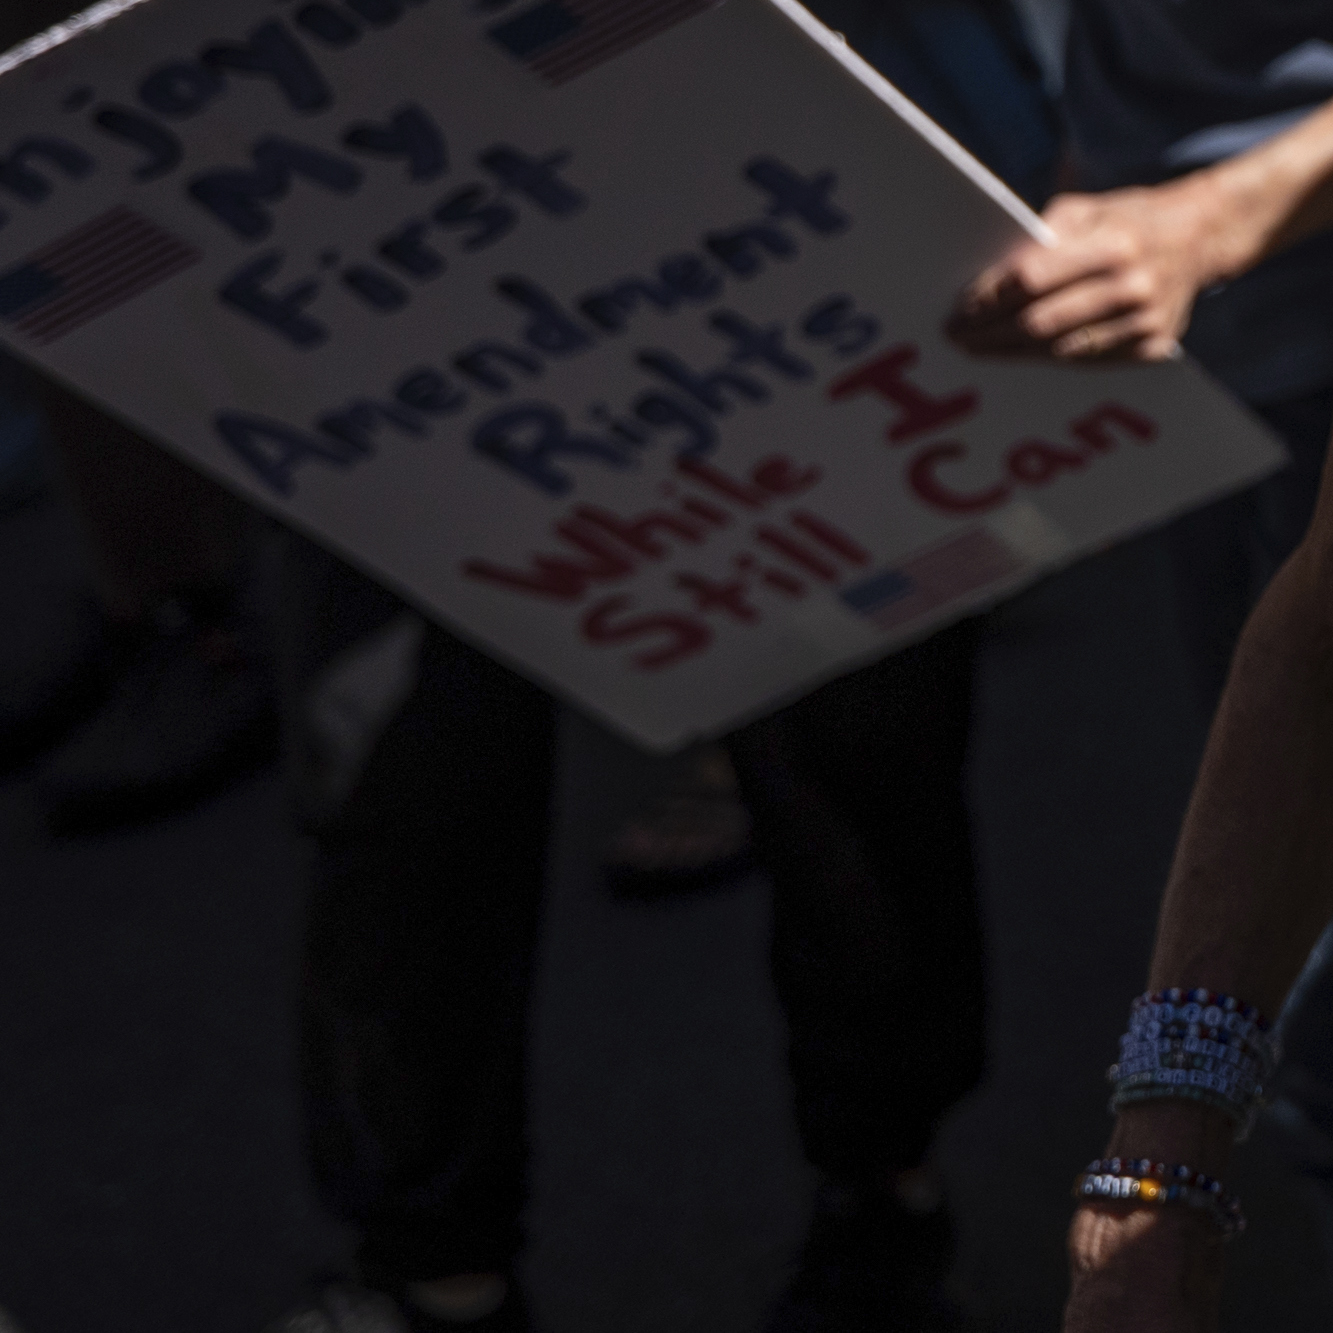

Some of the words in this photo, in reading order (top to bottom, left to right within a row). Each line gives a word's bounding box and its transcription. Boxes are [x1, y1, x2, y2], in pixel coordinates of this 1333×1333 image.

[189, 103, 447, 241] My
[218, 146, 587, 348] First
[214, 158, 849, 497] Amendment
[472, 294, 881, 497] Rights
[463, 453, 818, 600] While
[829, 345, 980, 443] I
[581, 513, 870, 669] Still
[907, 402, 1158, 515] Can
